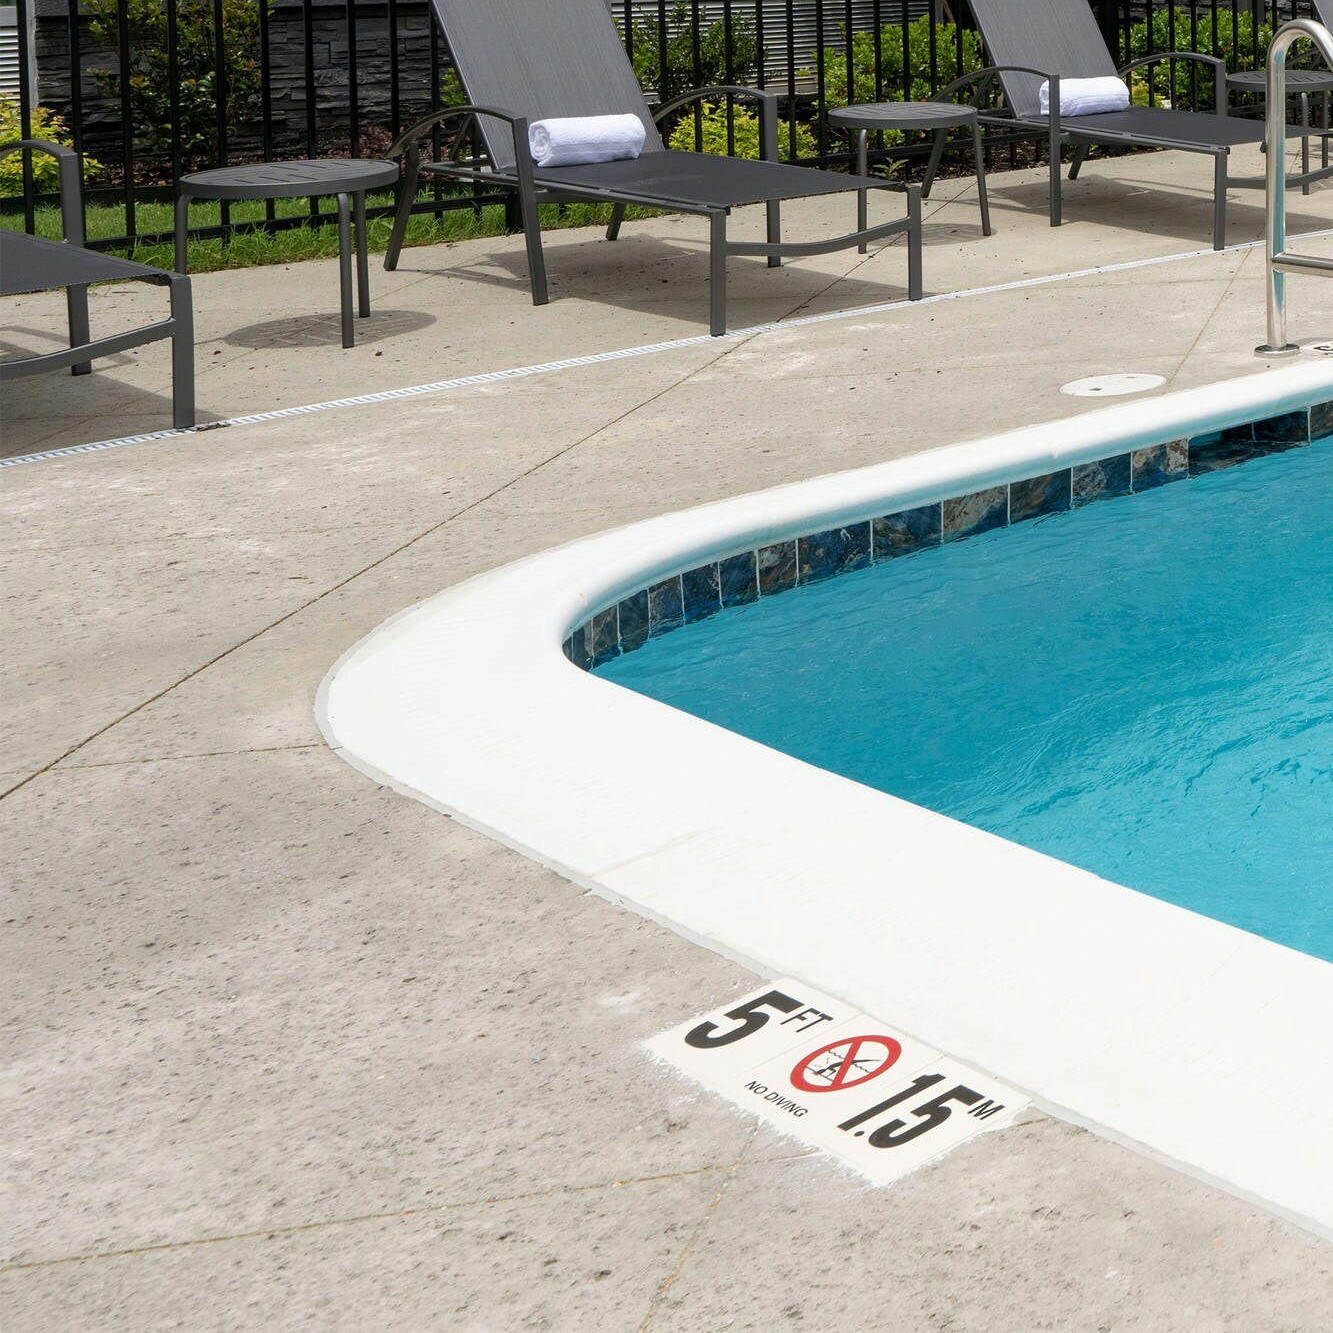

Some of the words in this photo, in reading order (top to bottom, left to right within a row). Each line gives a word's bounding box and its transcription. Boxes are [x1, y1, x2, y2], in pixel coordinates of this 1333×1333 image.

[684, 989, 805, 1050] 5
[779, 1007, 834, 1034] FT
[744, 1081, 768, 1094] NO
[763, 1091, 809, 1117] DIVING
[837, 1073, 984, 1150] 1.5
[968, 1099, 1006, 1121] M
